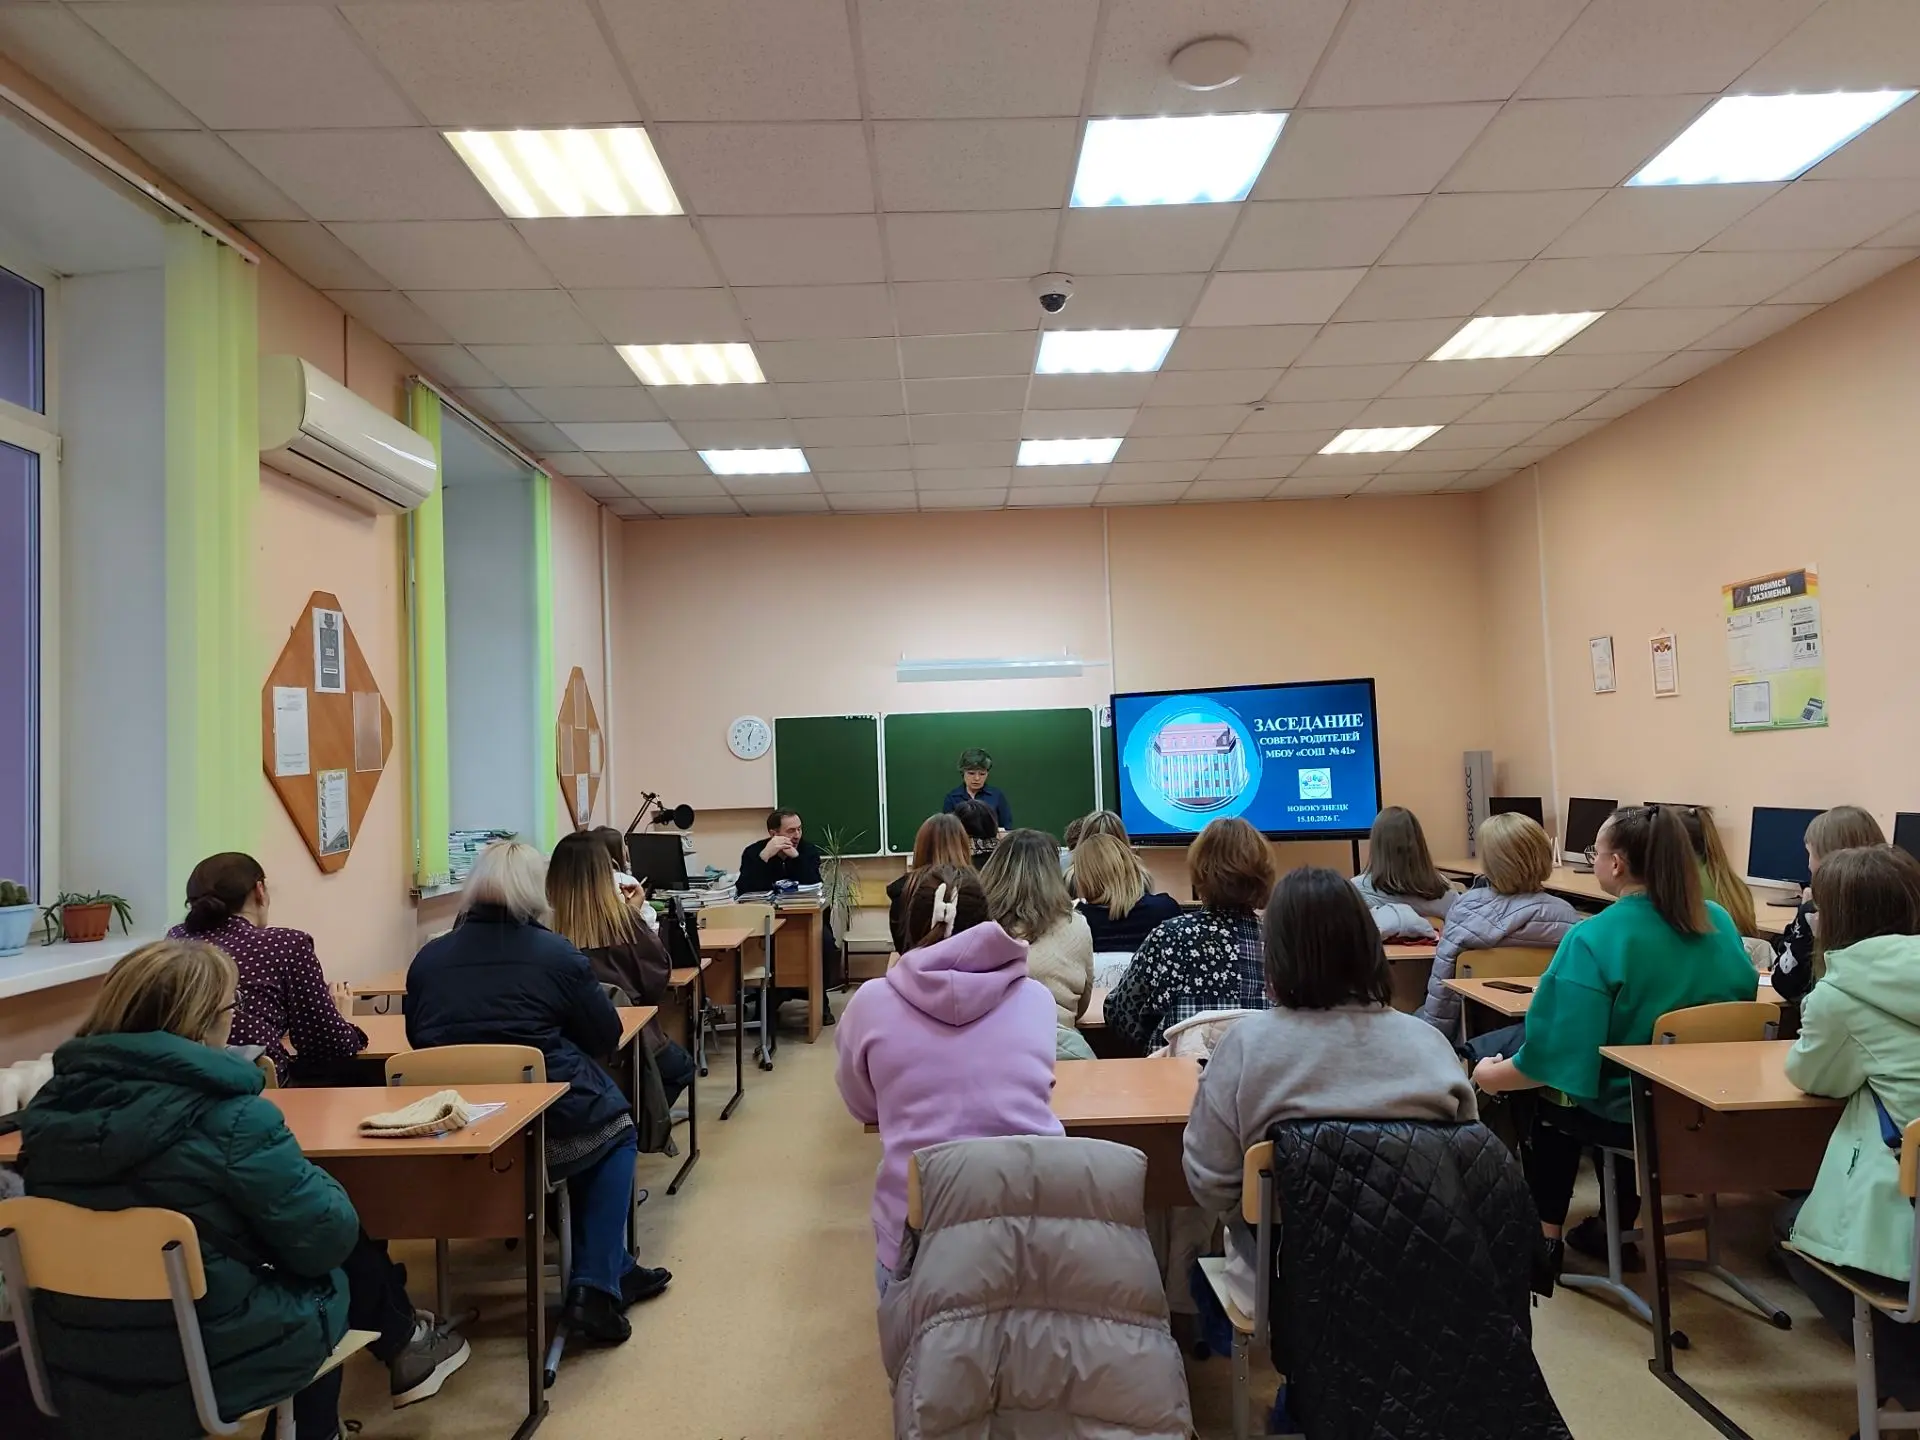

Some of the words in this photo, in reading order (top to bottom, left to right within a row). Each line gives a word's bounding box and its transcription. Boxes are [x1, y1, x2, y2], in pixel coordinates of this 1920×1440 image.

[1749, 577, 1787, 594] ГОТОВИМСЯ
[1752, 585, 1792, 602] ЭКЗАМЕНАМ
[1254, 713, 1364, 732] ЗАСЕДАНИЕ
[1260, 735, 1299, 746] СОВЕТА
[1300, 731, 1360, 745] РОДИТЕЛЕЙ
[1265, 749, 1294, 758] МБОУ
[1287, 803, 1349, 812] НОВОКУЗНЕЦК
[1465, 766, 1475, 841] КУЗБАСС
